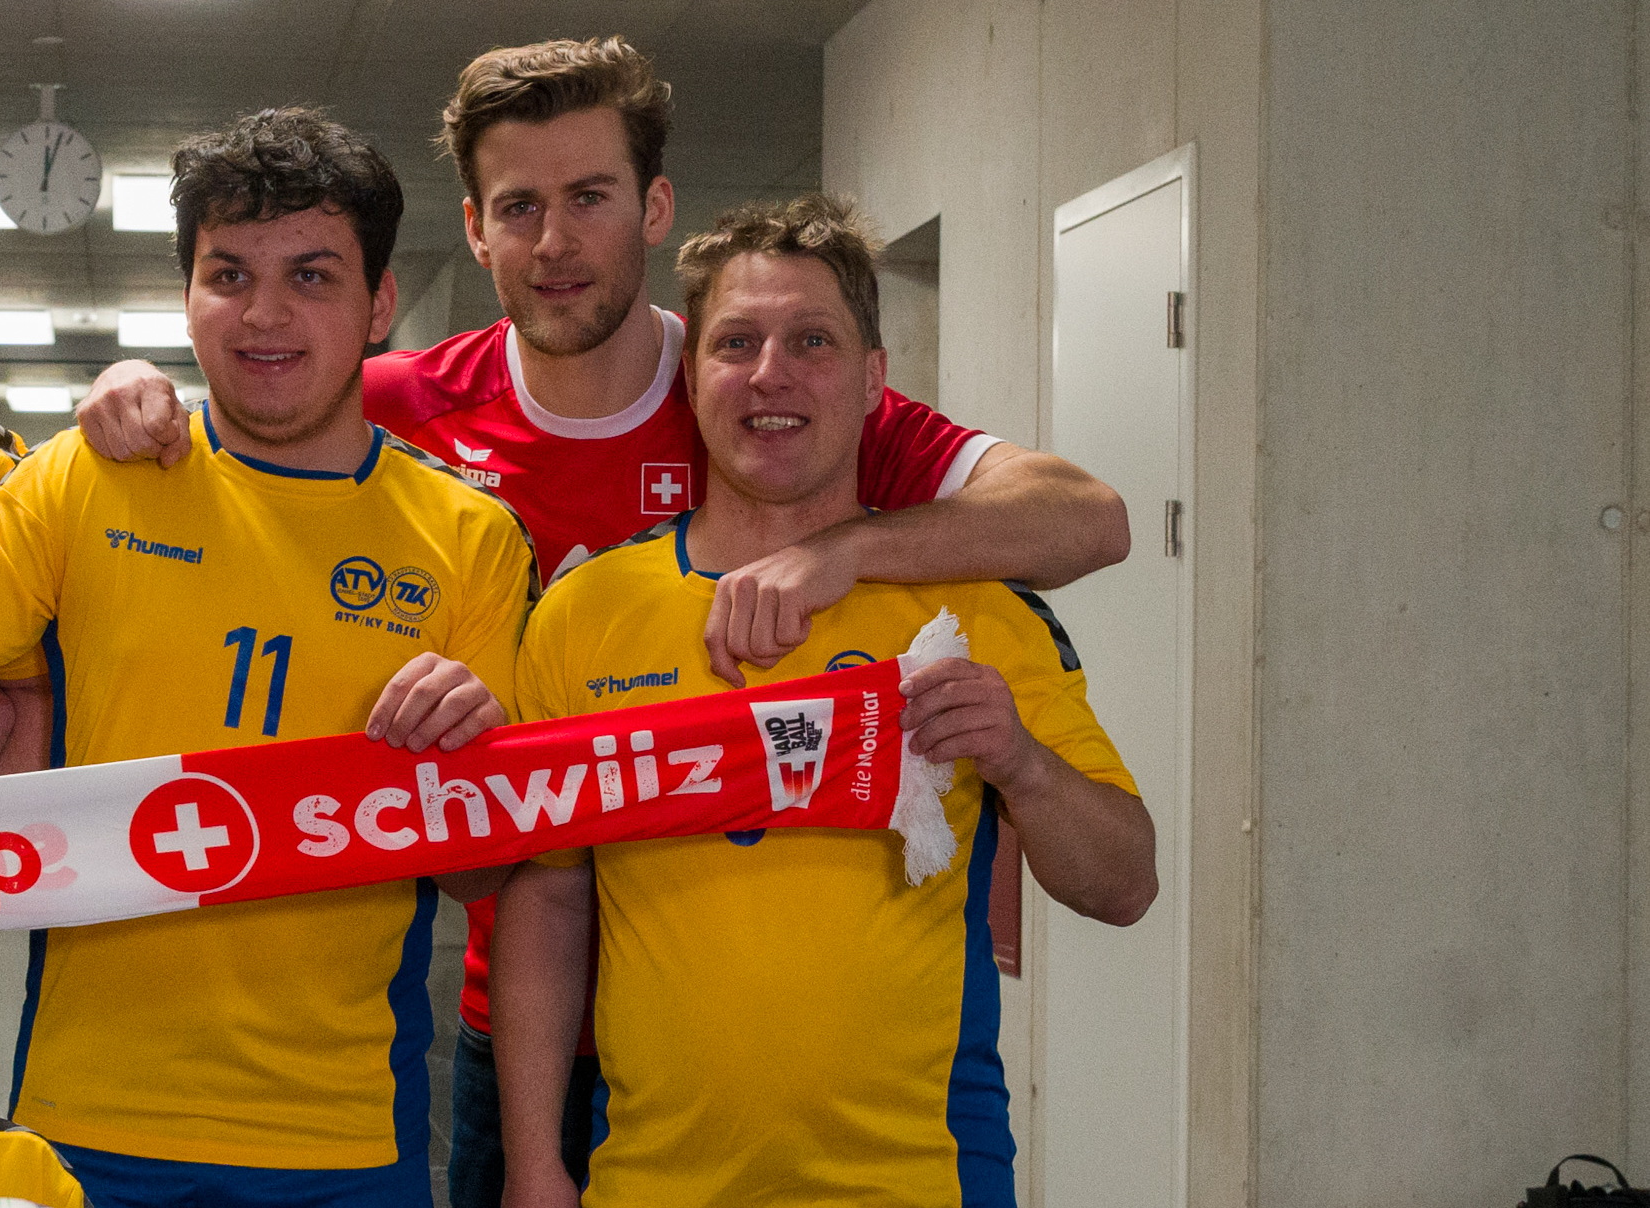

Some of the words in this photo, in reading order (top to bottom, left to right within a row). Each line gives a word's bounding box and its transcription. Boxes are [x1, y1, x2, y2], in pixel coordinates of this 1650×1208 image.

[127, 532, 204, 564] hummel
[331, 567, 386, 592] ATV
[386, 621, 422, 640] BASEL
[223, 626, 293, 737] 11
[608, 667, 679, 694] hummel
[785, 712, 807, 750] BALL
[855, 691, 880, 767] Mobiliar
[292, 730, 724, 858] schwiiz
[851, 771, 872, 801] die
